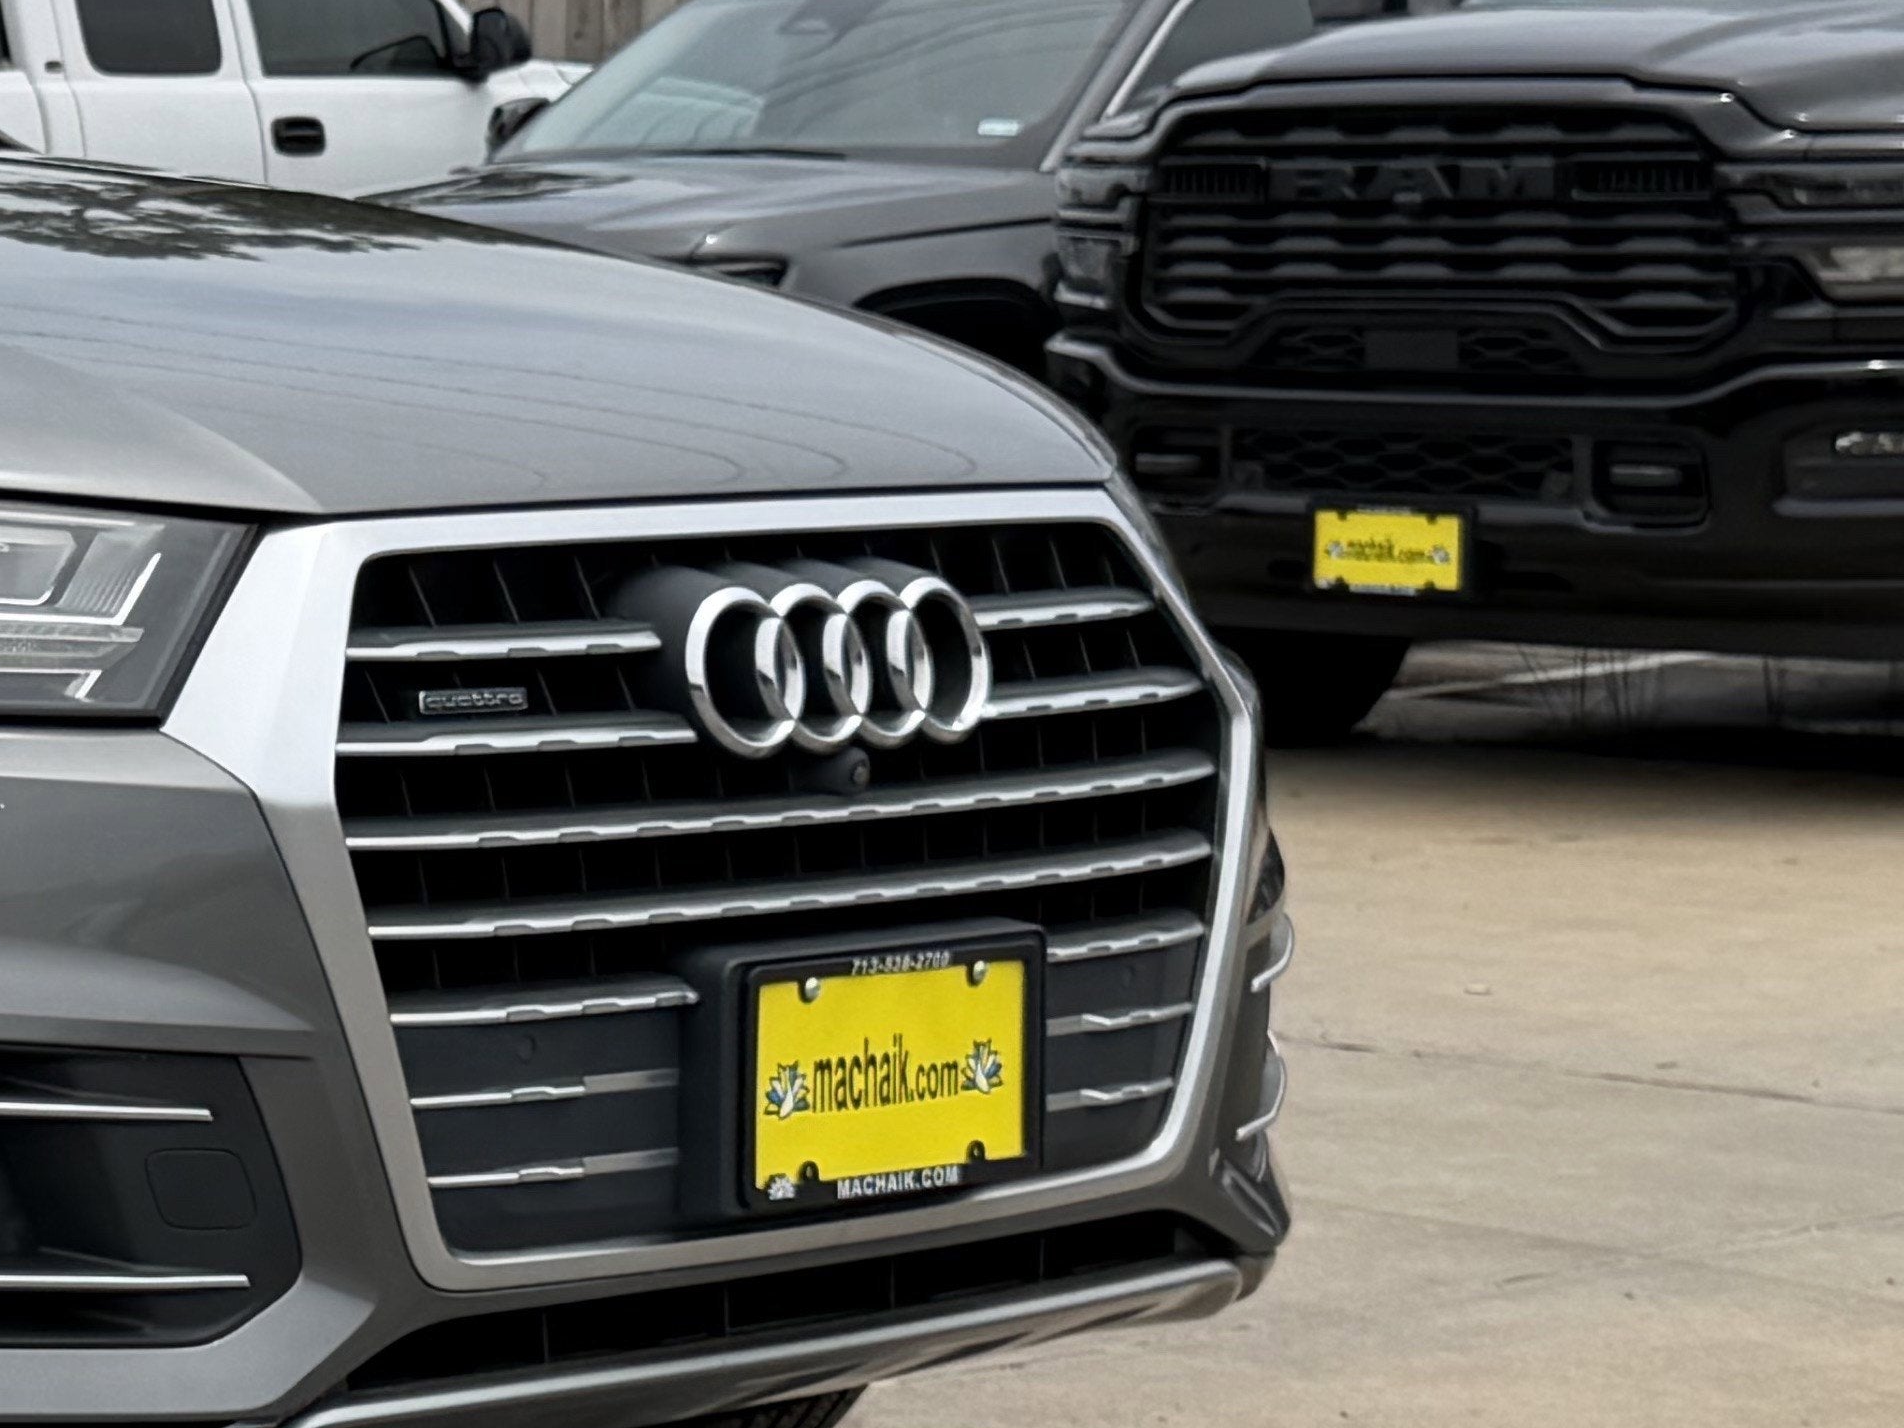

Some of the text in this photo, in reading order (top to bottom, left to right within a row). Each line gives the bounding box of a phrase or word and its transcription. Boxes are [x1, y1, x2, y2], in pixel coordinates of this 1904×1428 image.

[1269, 157, 1554, 200] RAM
[812, 1033, 959, 1113] machaik.com
[837, 1165, 959, 1199] MACHAIK.COM
